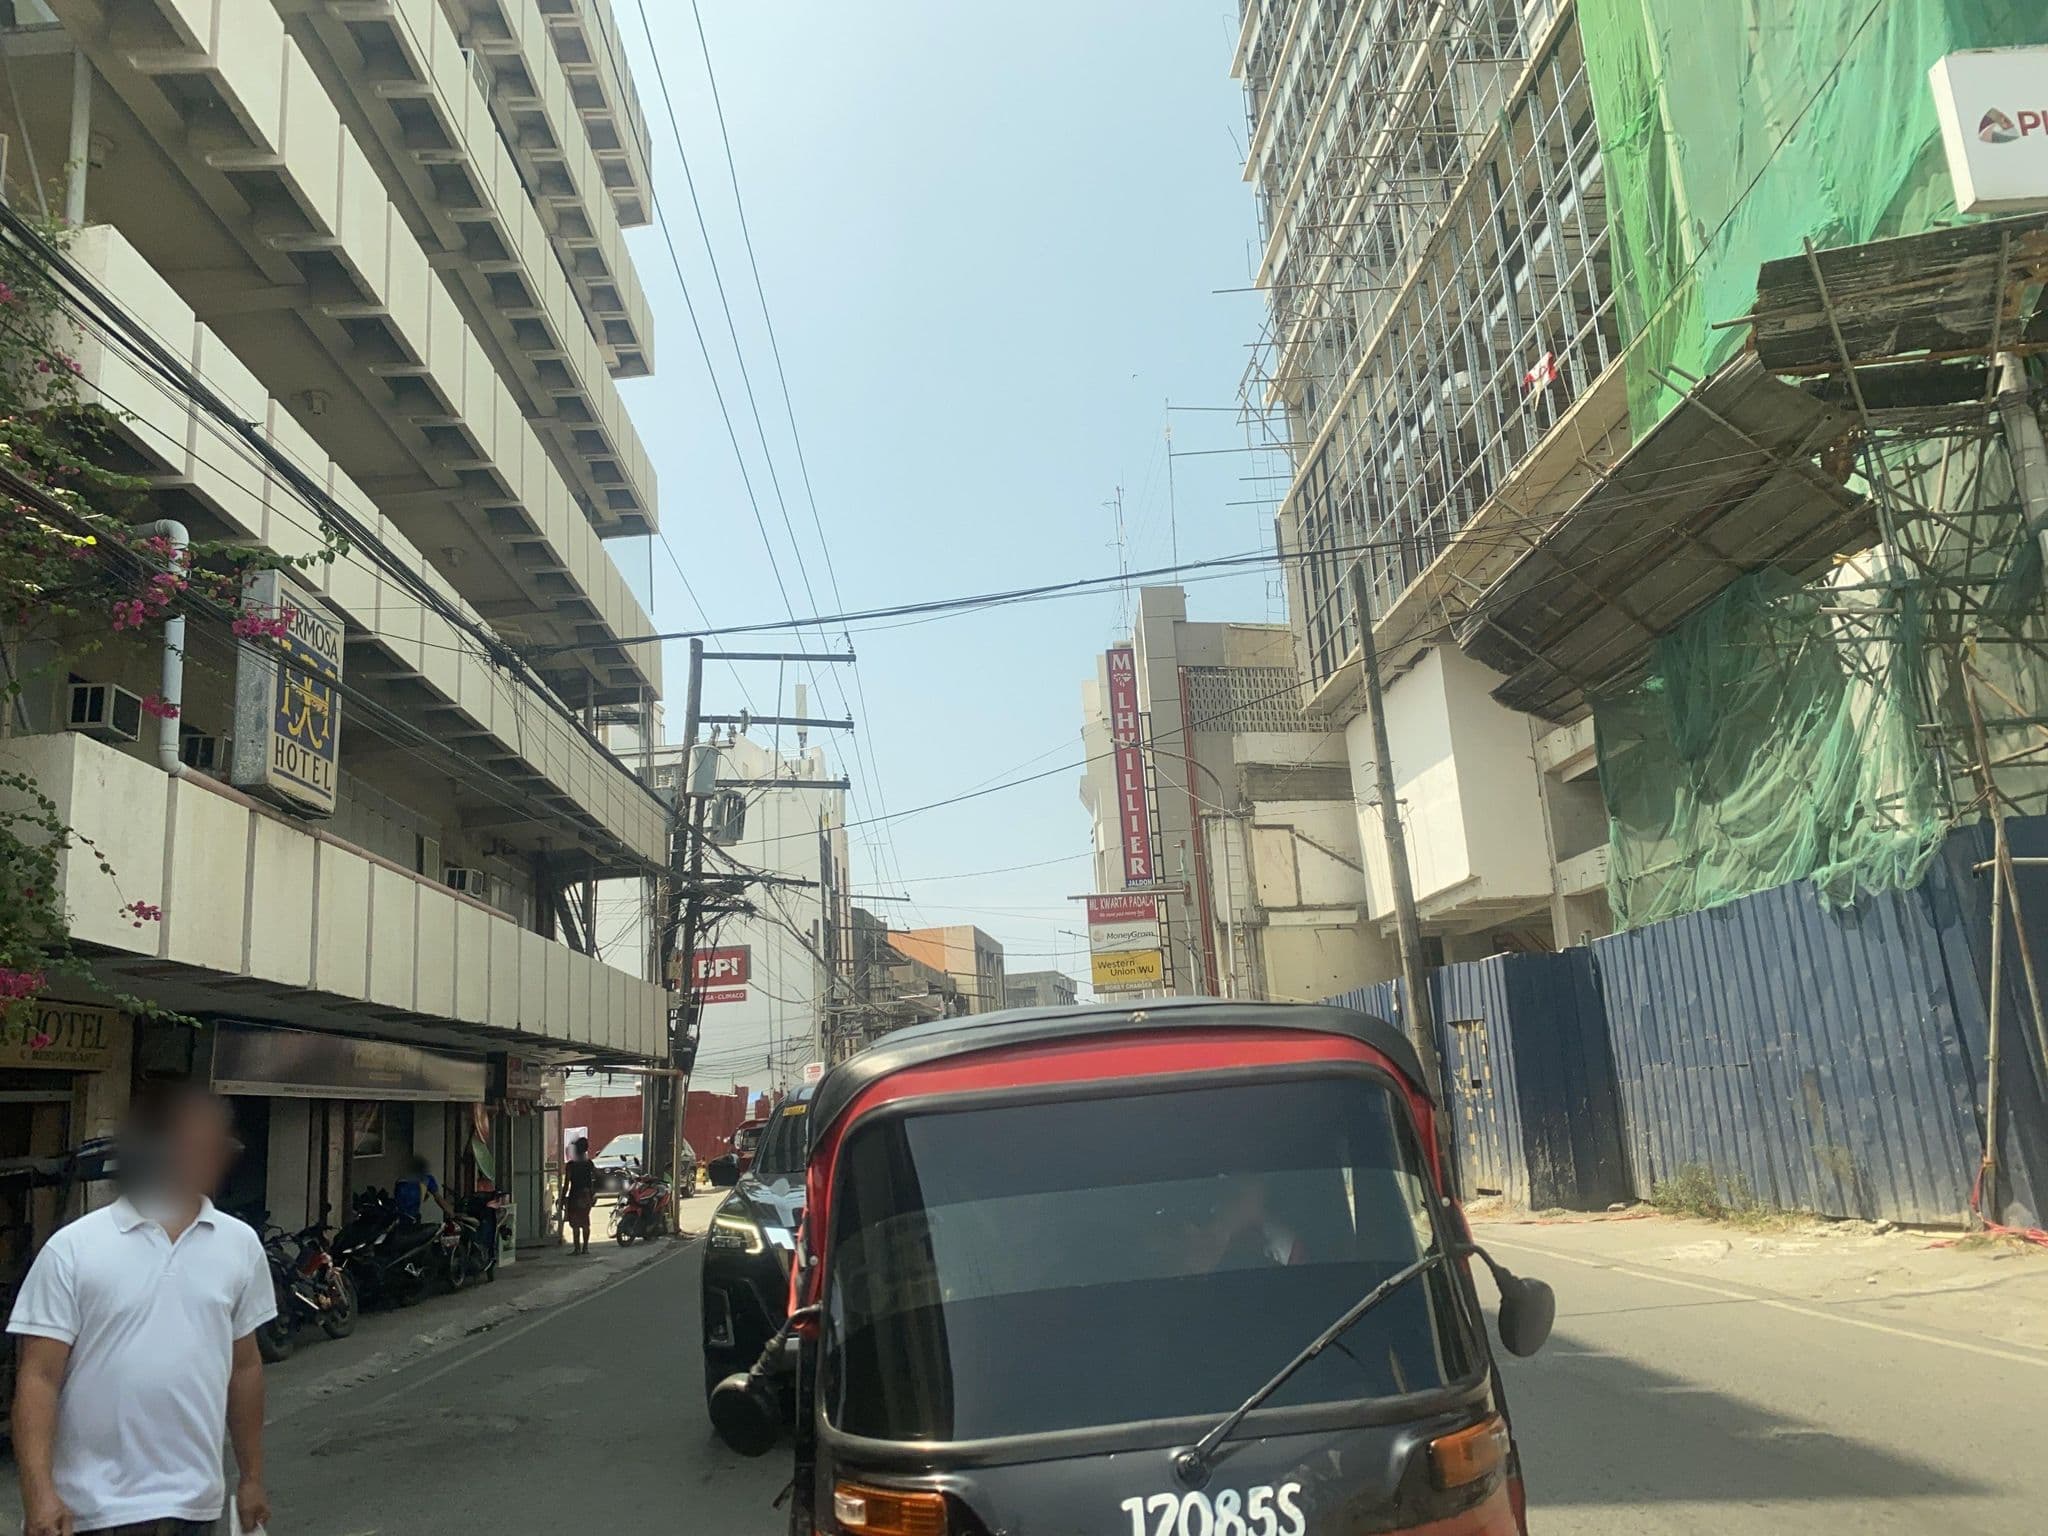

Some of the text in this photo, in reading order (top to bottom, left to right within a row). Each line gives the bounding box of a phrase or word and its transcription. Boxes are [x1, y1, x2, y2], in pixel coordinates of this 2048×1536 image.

[274, 736, 331, 790] HOTEL
[1116, 692, 1147, 876] LHUILLIER
[1101, 896, 1127, 909] KWARTA
[1129, 895, 1154, 908] PADALA
[1106, 930, 1154, 940] MoneyGram
[698, 957, 738, 978] BPI
[1098, 959, 1135, 969] Western
[1110, 967, 1136, 977] Union
[22, 1008, 106, 1049] HOTEL
